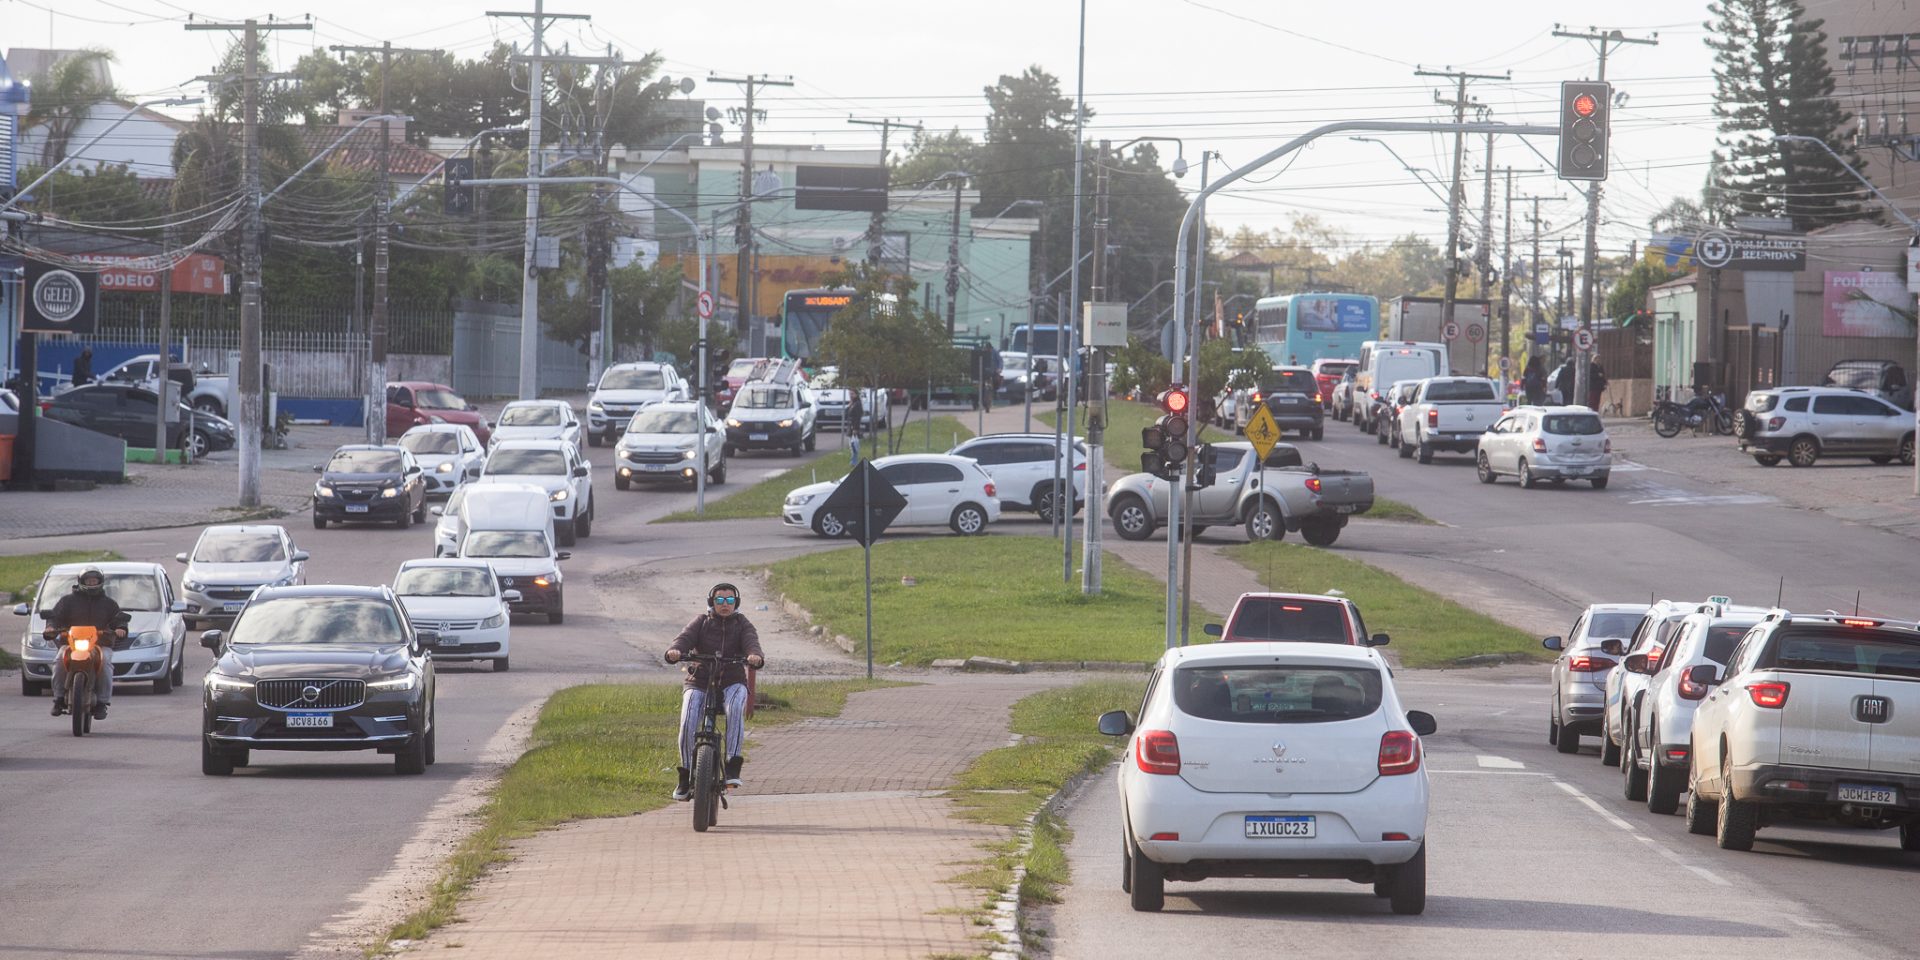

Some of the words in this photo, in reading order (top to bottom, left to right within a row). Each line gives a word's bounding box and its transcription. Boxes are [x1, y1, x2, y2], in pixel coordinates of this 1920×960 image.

[1742, 250, 1797, 260] REUNIDAS
[99, 273, 155, 287] ODEIO
[43, 286, 73, 303] GELEI
[1446, 325, 1455, 336] E
[1468, 328, 1480, 336] 60
[1579, 333, 1588, 344] E
[1862, 698, 1884, 716] FIAT
[290, 717, 328, 726] JCV8I66
[1843, 788, 1891, 802] JCW1F82
